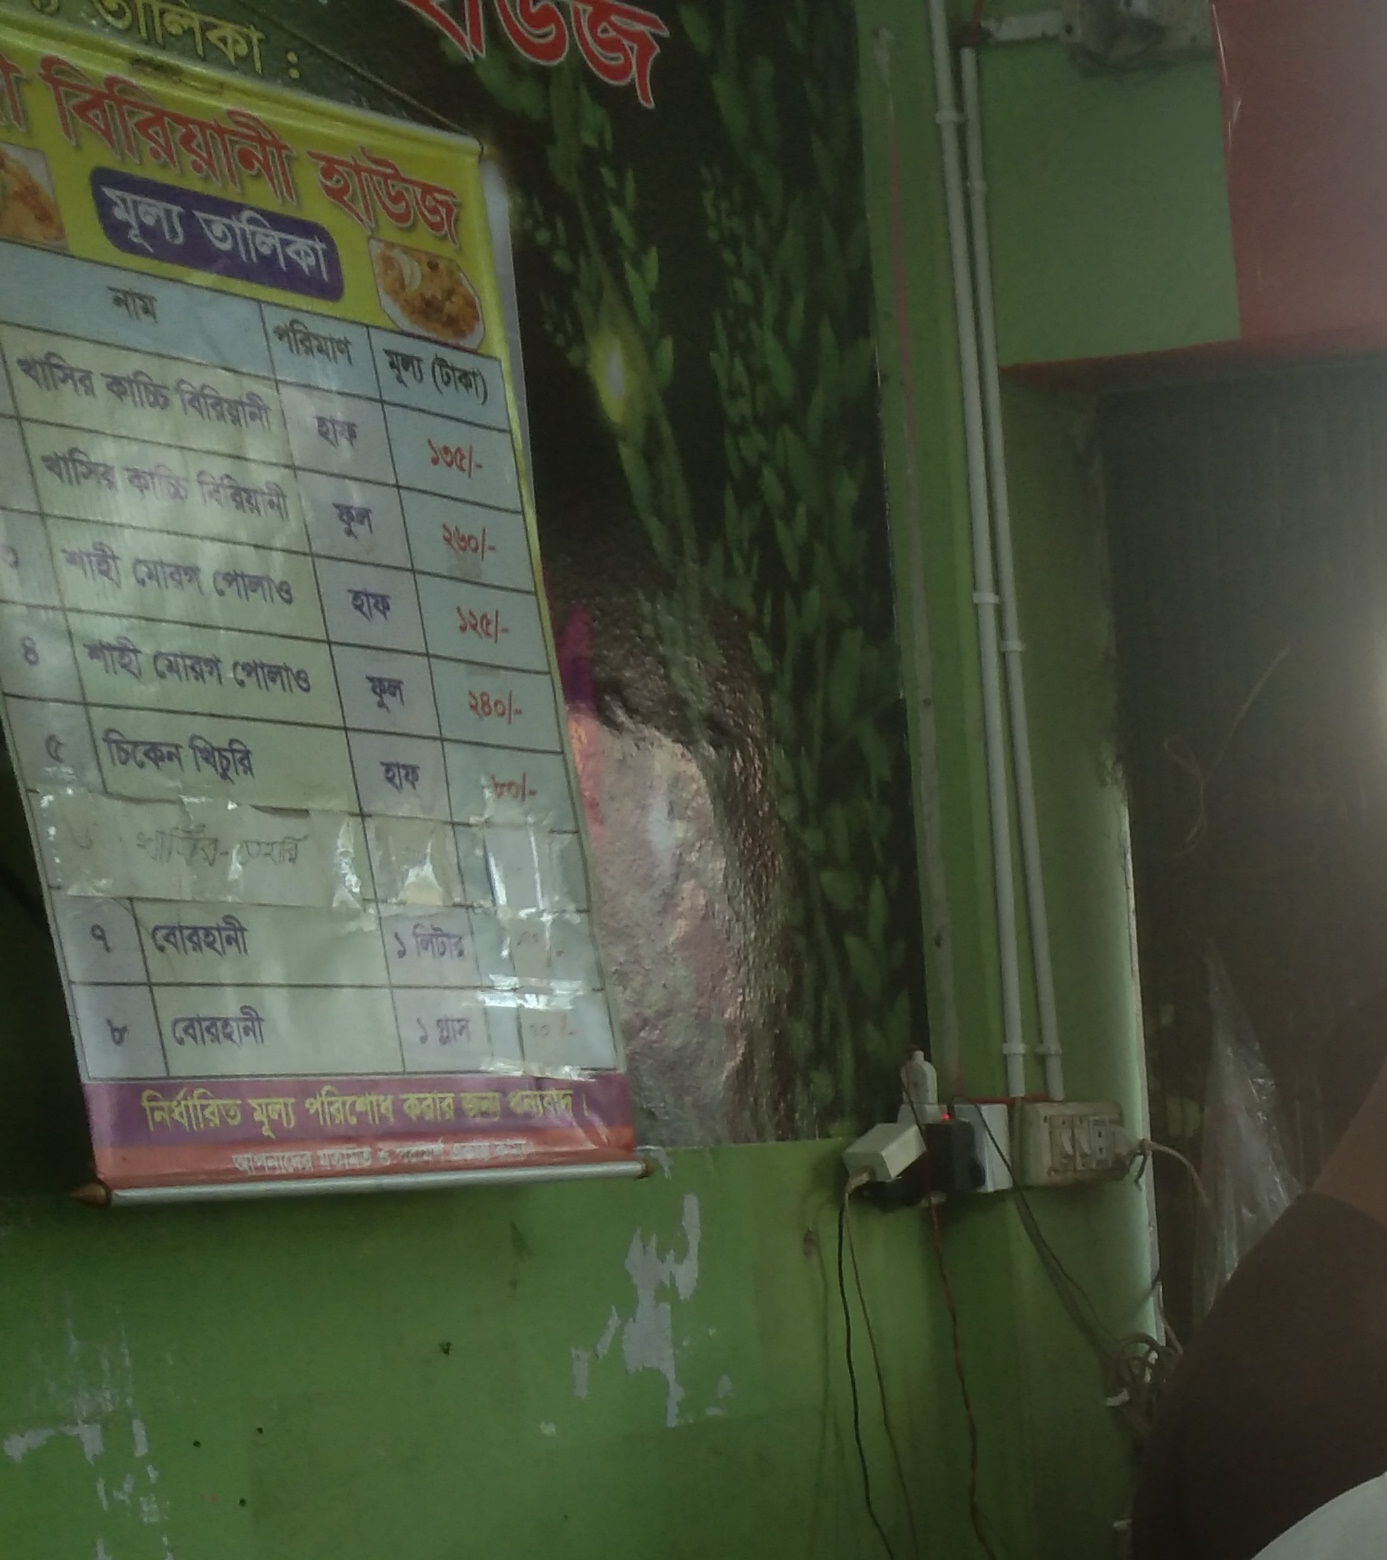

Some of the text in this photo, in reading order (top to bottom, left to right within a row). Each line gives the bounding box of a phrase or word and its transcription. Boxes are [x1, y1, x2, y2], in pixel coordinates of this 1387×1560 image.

[39, 54, 296, 205] বিরিয়ানী
[305, 146, 459, 248] হাউজ
[101, 185, 328, 282] মূল্য তালিকা
[108, 286, 158, 323] নাম
[383, 348, 424, 388] মূল্য
[431, 353, 488, 406] (টাকা)
[175, 378, 272, 431] বিরিয়ানী
[427, 439, 483, 478] ১৩৫/-
[332, 502, 374, 541] ফুল
[213, 569, 293, 604] পোলাও
[348, 587, 391, 622] হাফ
[456, 606, 509, 643] ১২৫/-
[153, 650, 223, 685] মোরগ
[232, 659, 311, 693] পোলাও
[366, 674, 405, 713] ফুল
[468, 689, 522, 725] ২৪০/-
[102, 728, 184, 771] চিকেন
[380, 760, 420, 791] হাফ
[91, 925, 111, 952] ৭
[151, 914, 249, 956] বোরহানী
[106, 1018, 127, 1046] ৮
[172, 1005, 265, 1046] বোরহানী
[141, 1087, 242, 1131] নির্ধারিত
[249, 1095, 297, 1139] মূল্য
[305, 1085, 395, 1126] পরিশোধ
